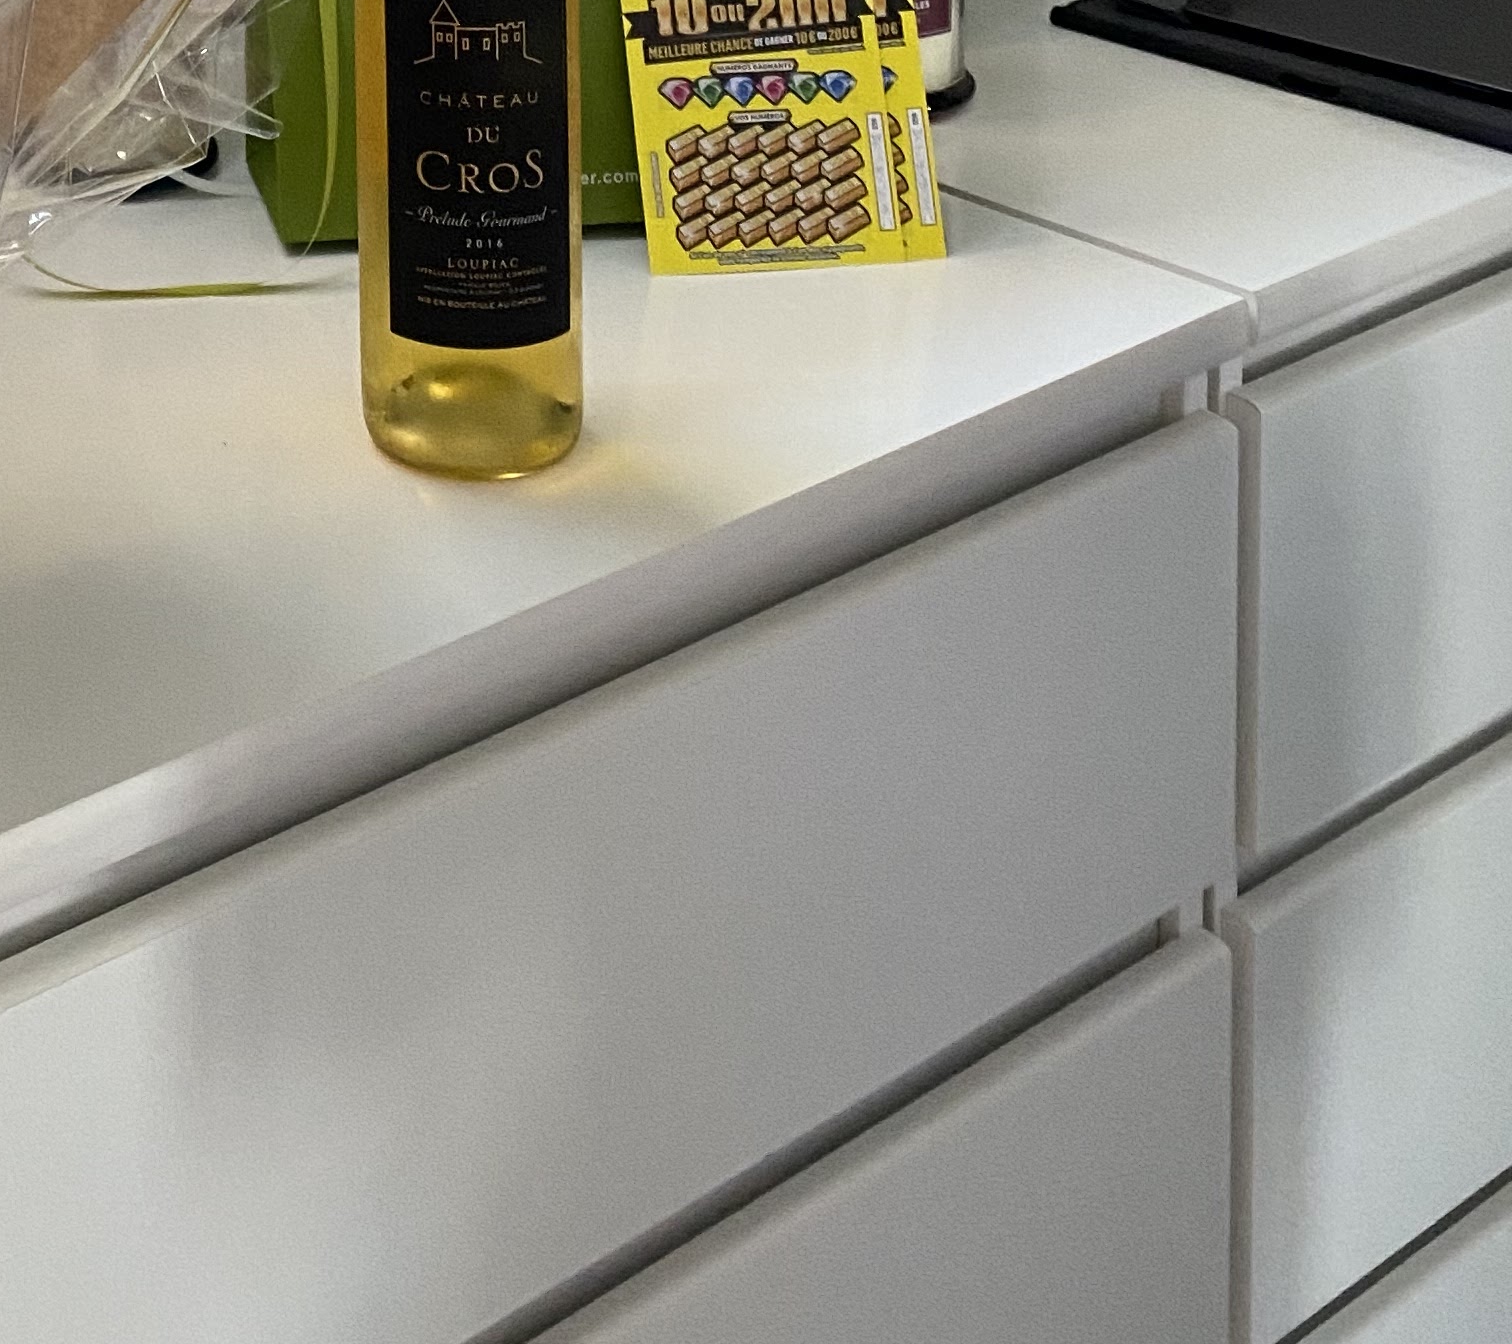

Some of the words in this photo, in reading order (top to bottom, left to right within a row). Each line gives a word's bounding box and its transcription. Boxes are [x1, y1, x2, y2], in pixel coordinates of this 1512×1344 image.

[711, 3, 745, 23] ou
[647, 41, 709, 60] MEILLEURE
[710, 37, 753, 53] CHANCE
[466, 125, 500, 144] DU
[416, 149, 544, 194] CROS
[580, 172, 639, 185] er.com
[466, 238, 504, 249] 2016
[447, 257, 520, 270] LOUPIAC
